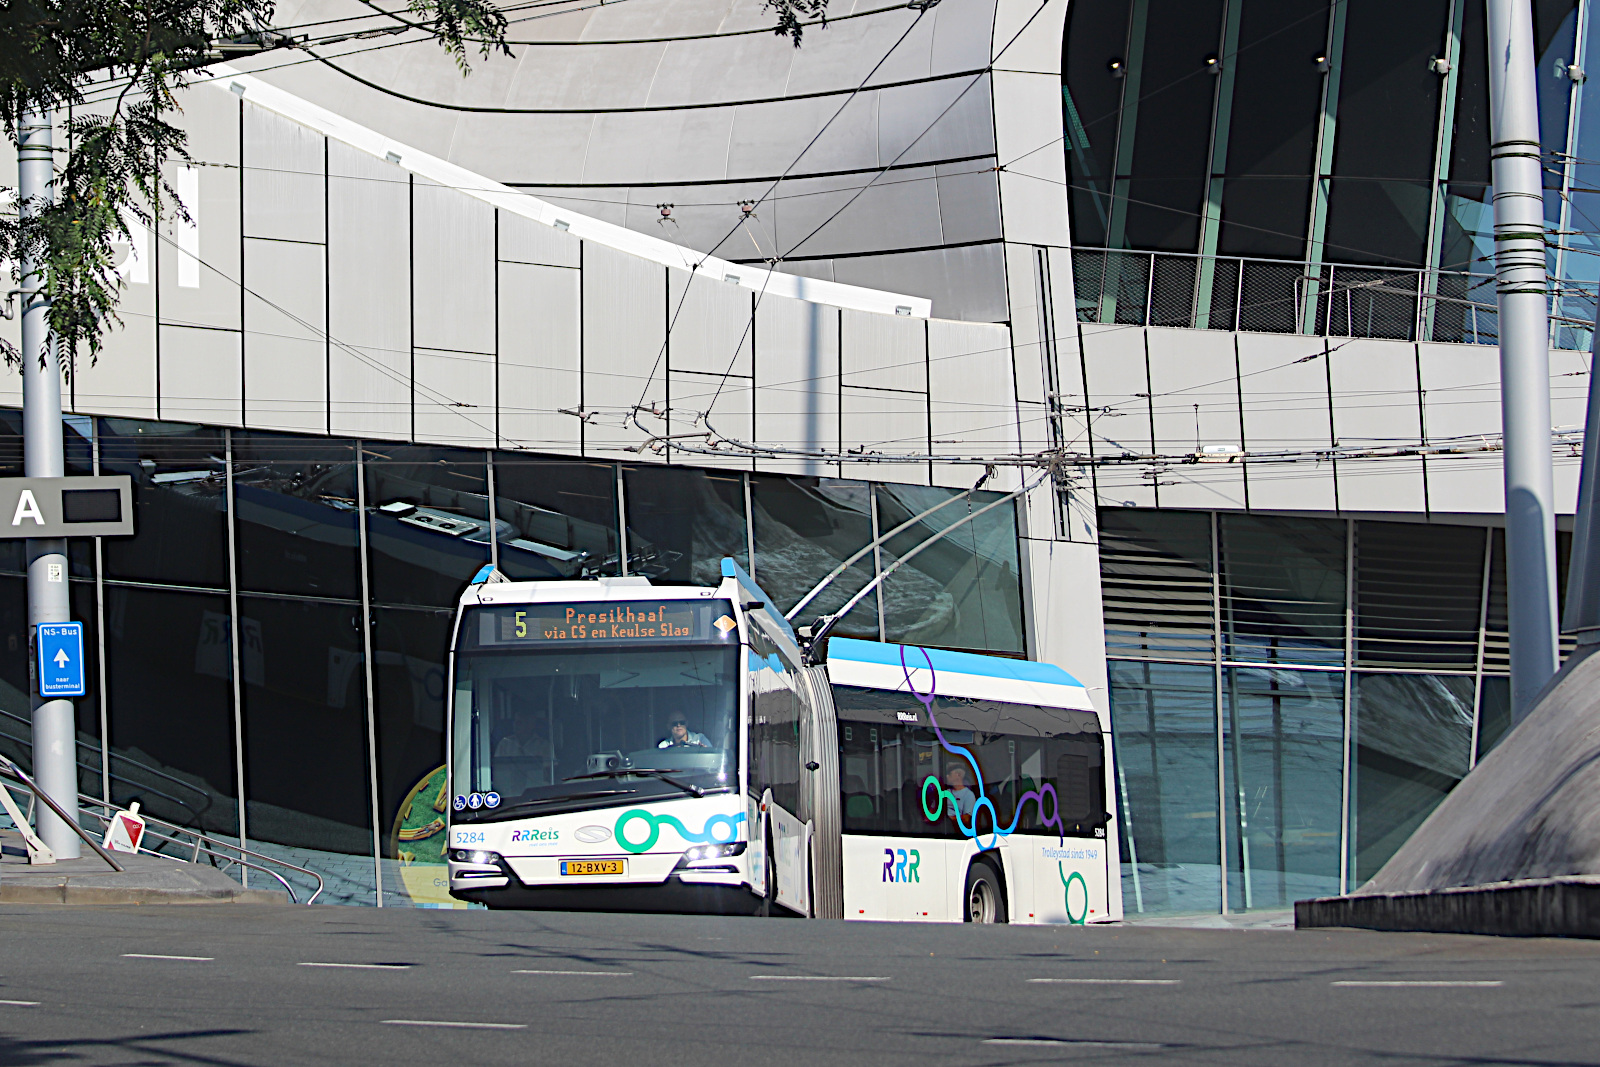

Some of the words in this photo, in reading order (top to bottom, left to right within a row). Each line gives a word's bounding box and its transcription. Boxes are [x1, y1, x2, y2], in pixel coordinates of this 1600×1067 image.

[11, 489, 46, 526] A
[565, 605, 667, 624] Presikhaaf
[514, 611, 527, 638] 5
[544, 626, 566, 640] via
[571, 626, 586, 639] CS
[591, 628, 607, 638] en
[611, 624, 655, 638] Keulse
[660, 624, 689, 637] Slag
[45, 682, 80, 690] busterminal
[456, 831, 486, 844] 5284
[511, 826, 560, 842] RRReis
[1042, 847, 1070, 860] Trolleystad
[1070, 848, 1085, 859] sinds
[1085, 849, 1098, 859] 1949
[572, 862, 617, 873] 12-BXV-3
[882, 848, 920, 883] RRR
